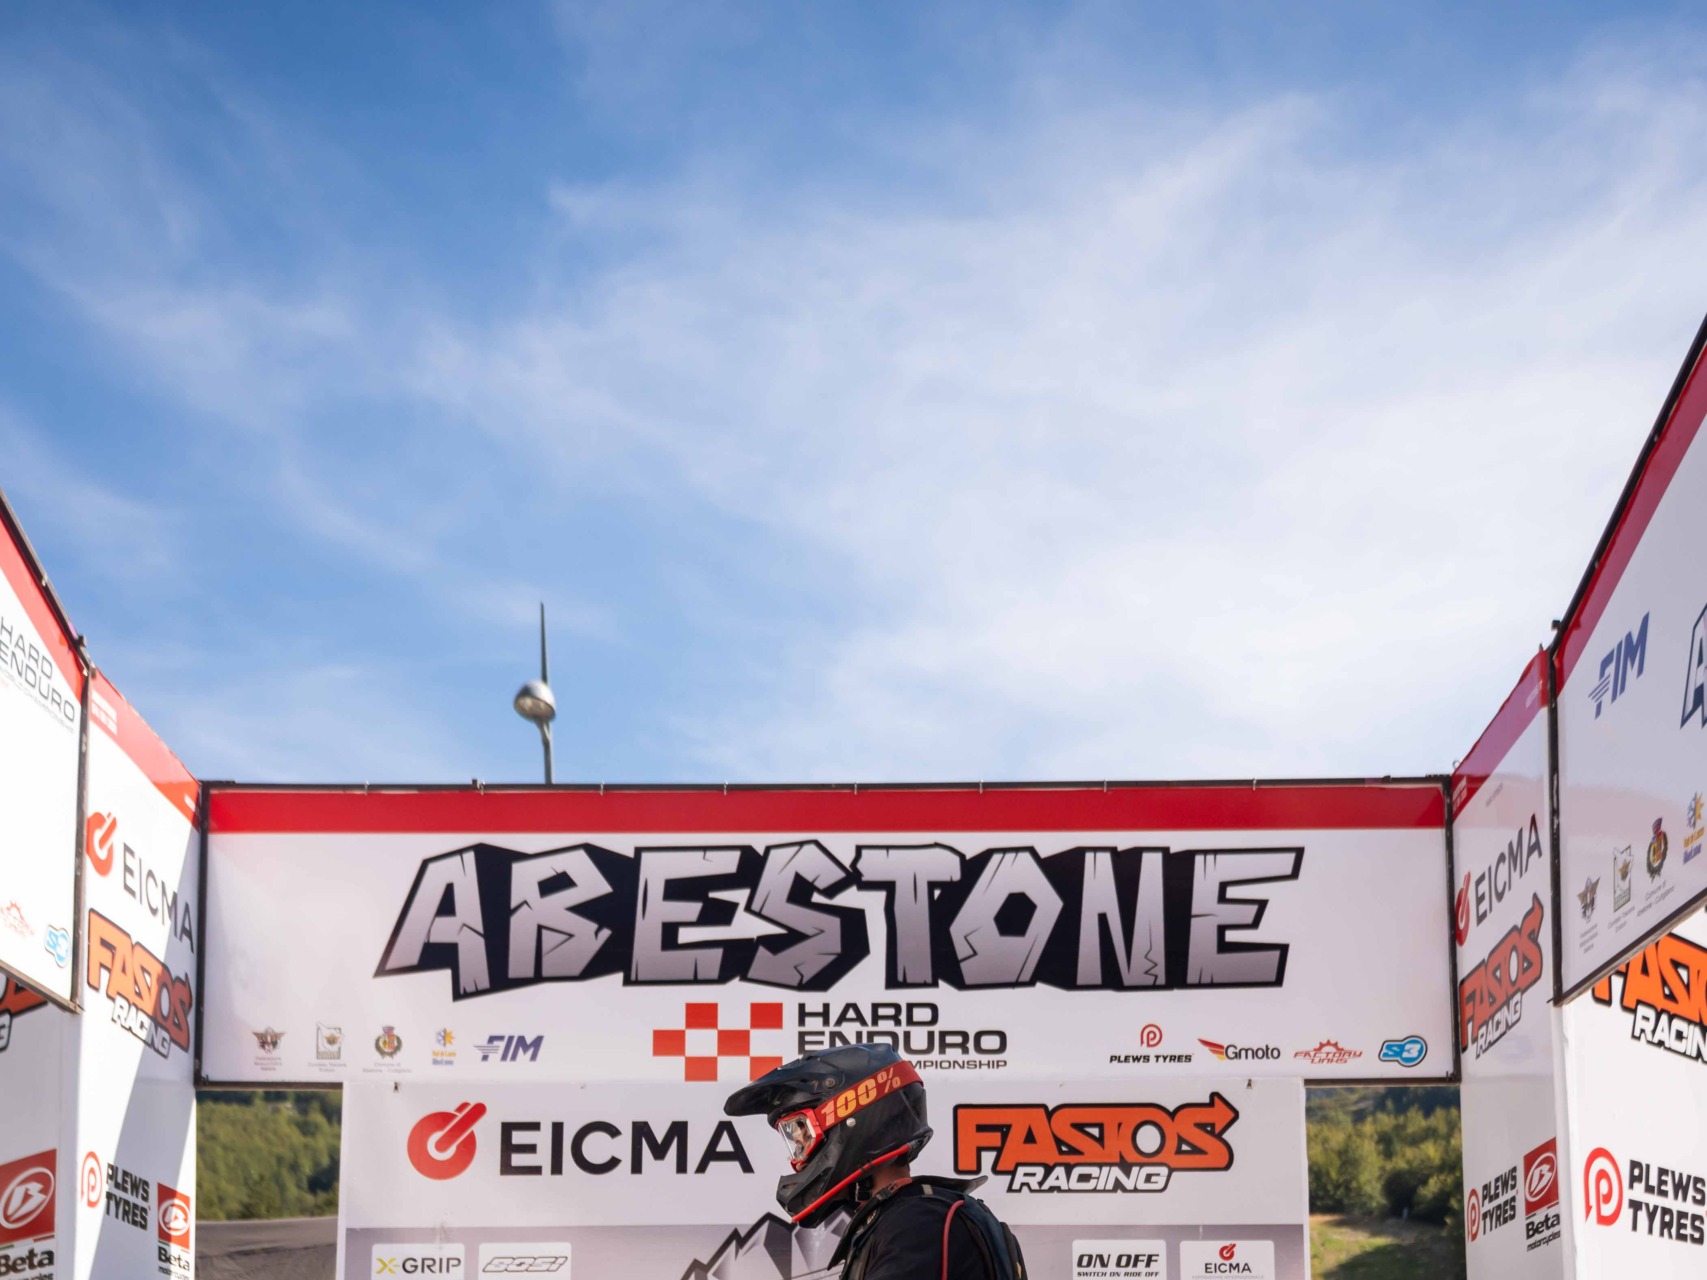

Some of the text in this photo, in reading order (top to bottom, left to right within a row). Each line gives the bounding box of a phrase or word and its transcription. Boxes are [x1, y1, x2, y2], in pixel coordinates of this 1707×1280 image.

[1475, 813, 1542, 927] EICMA
[123, 842, 195, 954] EICMA
[374, 840, 1304, 1001] ABESTONE
[112, 997, 171, 1059] RACING
[798, 1002, 939, 1027] HARD
[1476, 992, 1522, 1059] RACING
[1632, 1000, 1707, 1065] RACIN
[473, 1035, 544, 1062] FIM
[909, 1060, 1007, 1069] MPIONSHIP
[1109, 1054, 1192, 1064] PLEWS TYRES
[1224, 1044, 1281, 1060] Gmoto
[821, 1067, 901, 1127] 100%
[500, 1121, 755, 1176] EICMA
[107, 1162, 149, 1203] PLEWS
[1007, 1162, 1172, 1195] RACING
[1482, 1166, 1517, 1207] PLEWS
[1628, 1159, 1706, 1207] PLEWS
[106, 1191, 148, 1231] TYRES
[1482, 1197, 1516, 1236] TYRES
[1525, 1212, 1560, 1240] Beta
[1628, 1198, 1705, 1246] TYRES
[0, 1249, 55, 1277] Beta
[158, 1246, 190, 1271] Beta
[376, 1257, 461, 1274] X-GRIP
[1076, 1253, 1159, 1268] ON OFF
[1204, 1262, 1252, 1273] EICMA
